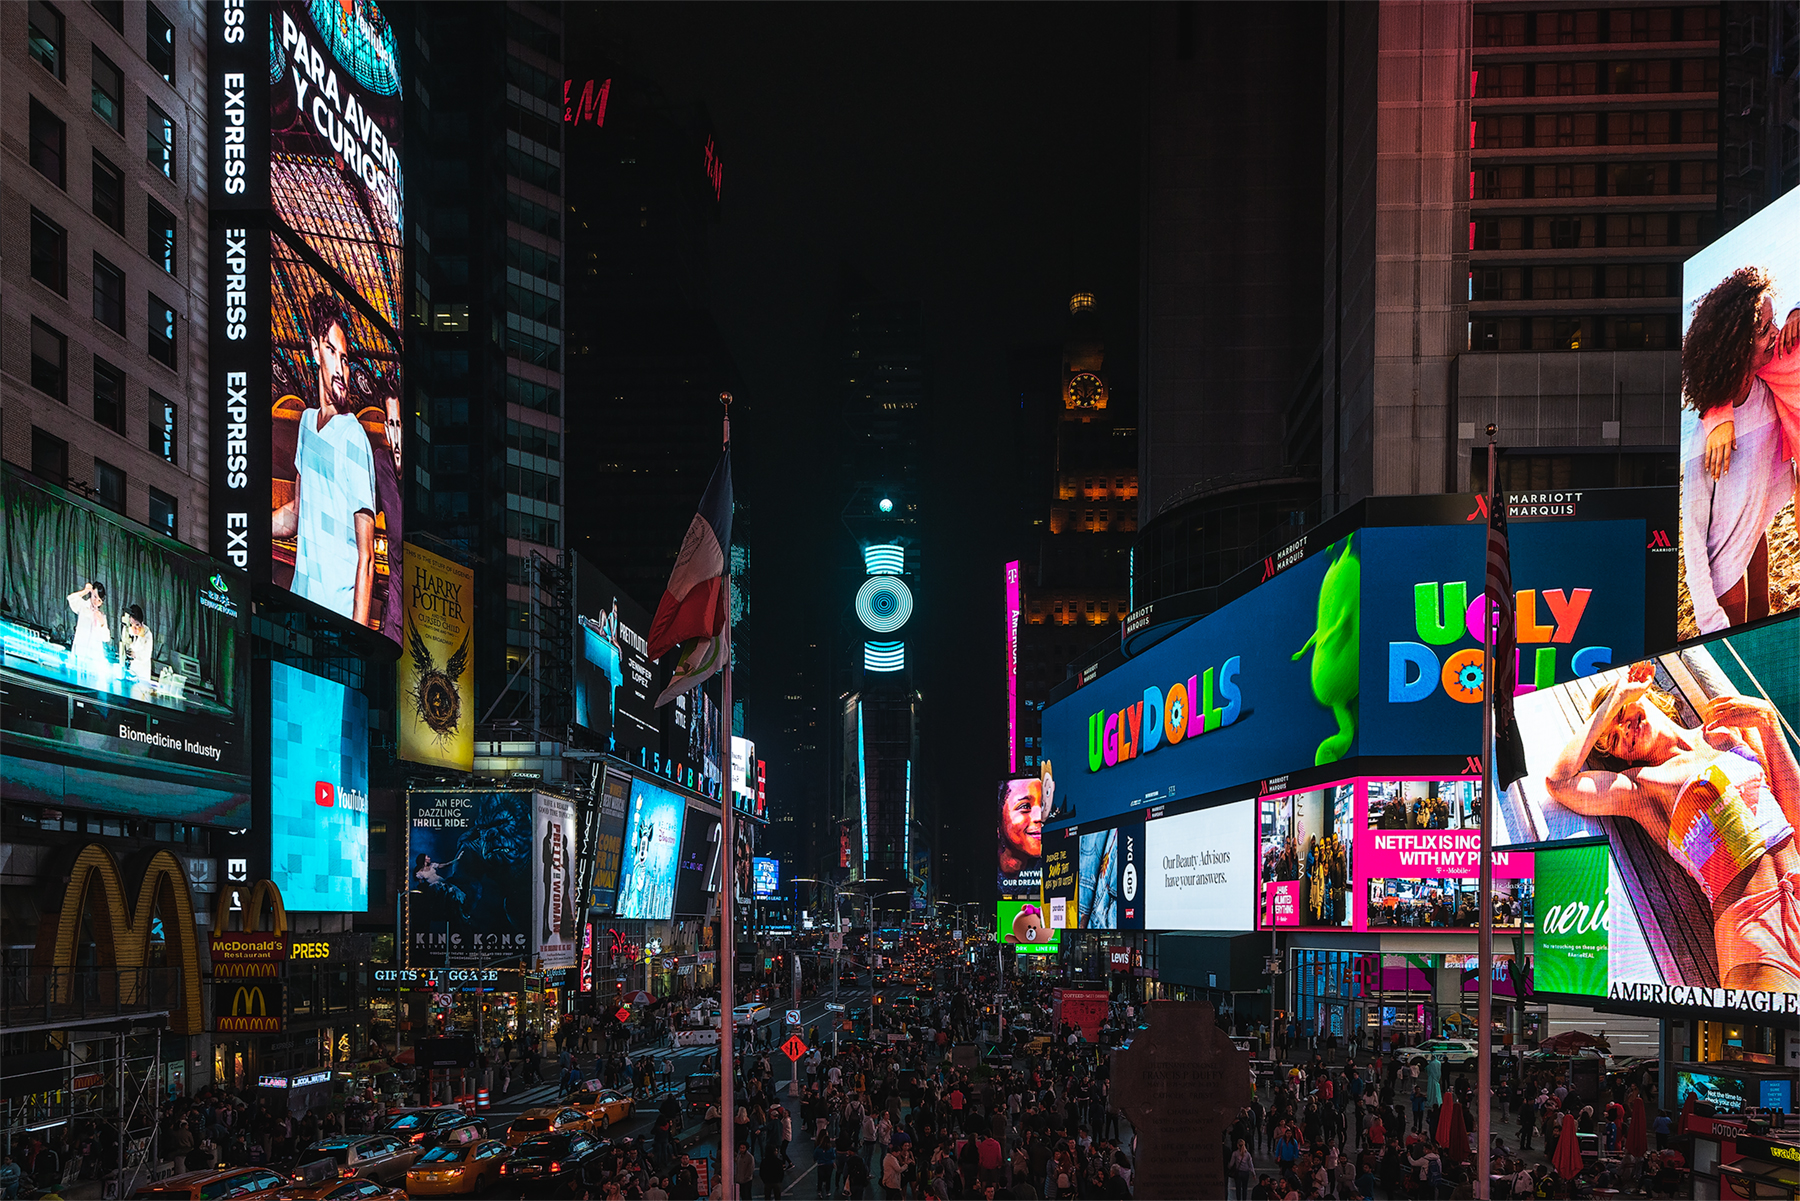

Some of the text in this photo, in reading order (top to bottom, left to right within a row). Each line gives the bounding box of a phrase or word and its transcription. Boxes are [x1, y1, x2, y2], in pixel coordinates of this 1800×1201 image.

[282, 10, 342, 114] PARA
[291, 65, 308, 112] Y
[224, 73, 246, 195] EXPRESS
[227, 371, 247, 489] EXPRESS
[1509, 492, 1583, 503] MARRIOTT
[1509, 505, 1575, 516] MARQUIS
[227, 512, 247, 572] EXP
[1277, 536, 1307, 560] MARRIOTT
[1277, 549, 1304, 571] MARQUIS
[415, 566, 462, 602] HARRY
[412, 585, 465, 623] POTTER
[1414, 580, 1592, 645] UGLY
[418, 613, 460, 634] CURSED CHILD
[628, 657, 653, 680] JENNIFER
[632, 670, 648, 688] LOPEZ
[1088, 655, 1242, 773] UGLYDOLLS
[118, 724, 222, 761] Biomedicine Industry
[337, 786, 365, 812] YouTube
[413, 818, 442, 827] THRILL
[419, 808, 461, 818] DAZZLING
[582, 810, 593, 855] MAC
[1375, 836, 1481, 850] NETFLIX IS INC
[553, 824, 561, 872] PRETTY
[598, 833, 621, 854] COME
[1163, 850, 1230, 871] Our Beauty Advisors
[1400, 852, 1438, 865] WITH
[1441, 852, 1466, 865] MY
[576, 858, 586, 903] MAC
[593, 869, 617, 889] AWAY
[1165, 871, 1228, 890] have your answers.
[553, 881, 561, 933] WOMAN
[213, 941, 283, 951] McDonald's
[416, 933, 526, 945] KING KONG
[290, 942, 330, 959] PRESS
[374, 970, 498, 981] GIFTS LGGAGE
[1492, 965, 1507, 982] YC
[1610, 981, 1799, 1013] AMERICAN EAGLE
[1142, 1071, 1181, 1080] FRANCIS
[1192, 1071, 1224, 1080] DUFFY
[155, 1168, 172, 1182] YPD
